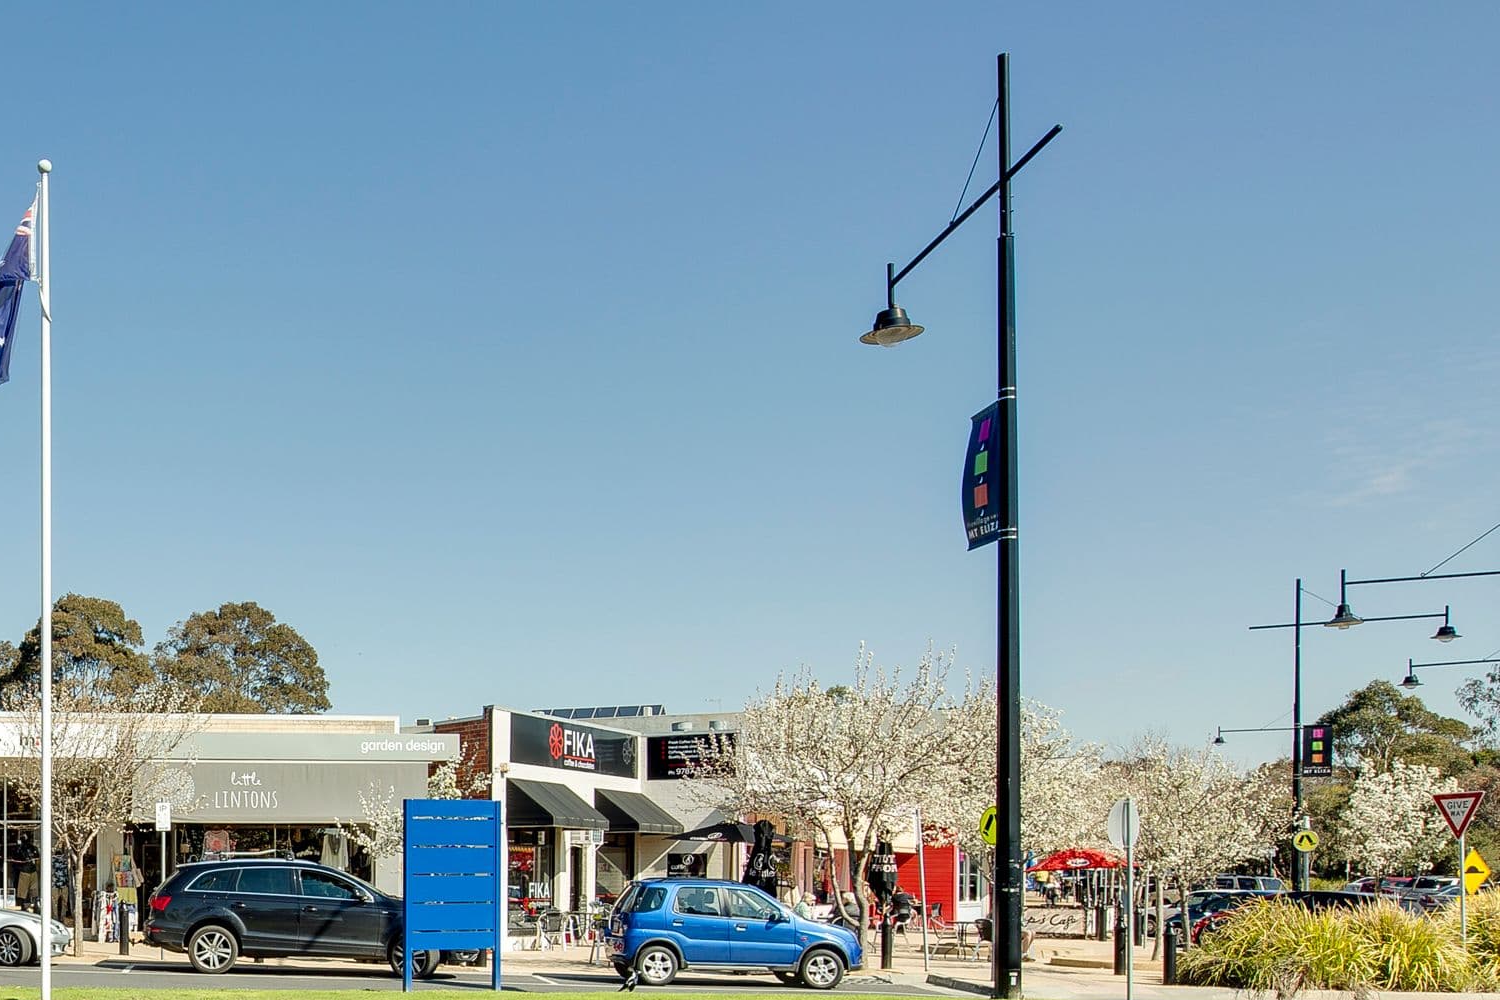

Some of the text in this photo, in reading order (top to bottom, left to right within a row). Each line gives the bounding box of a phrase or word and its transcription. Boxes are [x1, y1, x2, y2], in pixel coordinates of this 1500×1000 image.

[361, 739, 445, 754] garden design
[231, 771, 262, 786] little
[215, 791, 278, 809] LINTONS
[1447, 801, 1469, 810] GIVE
